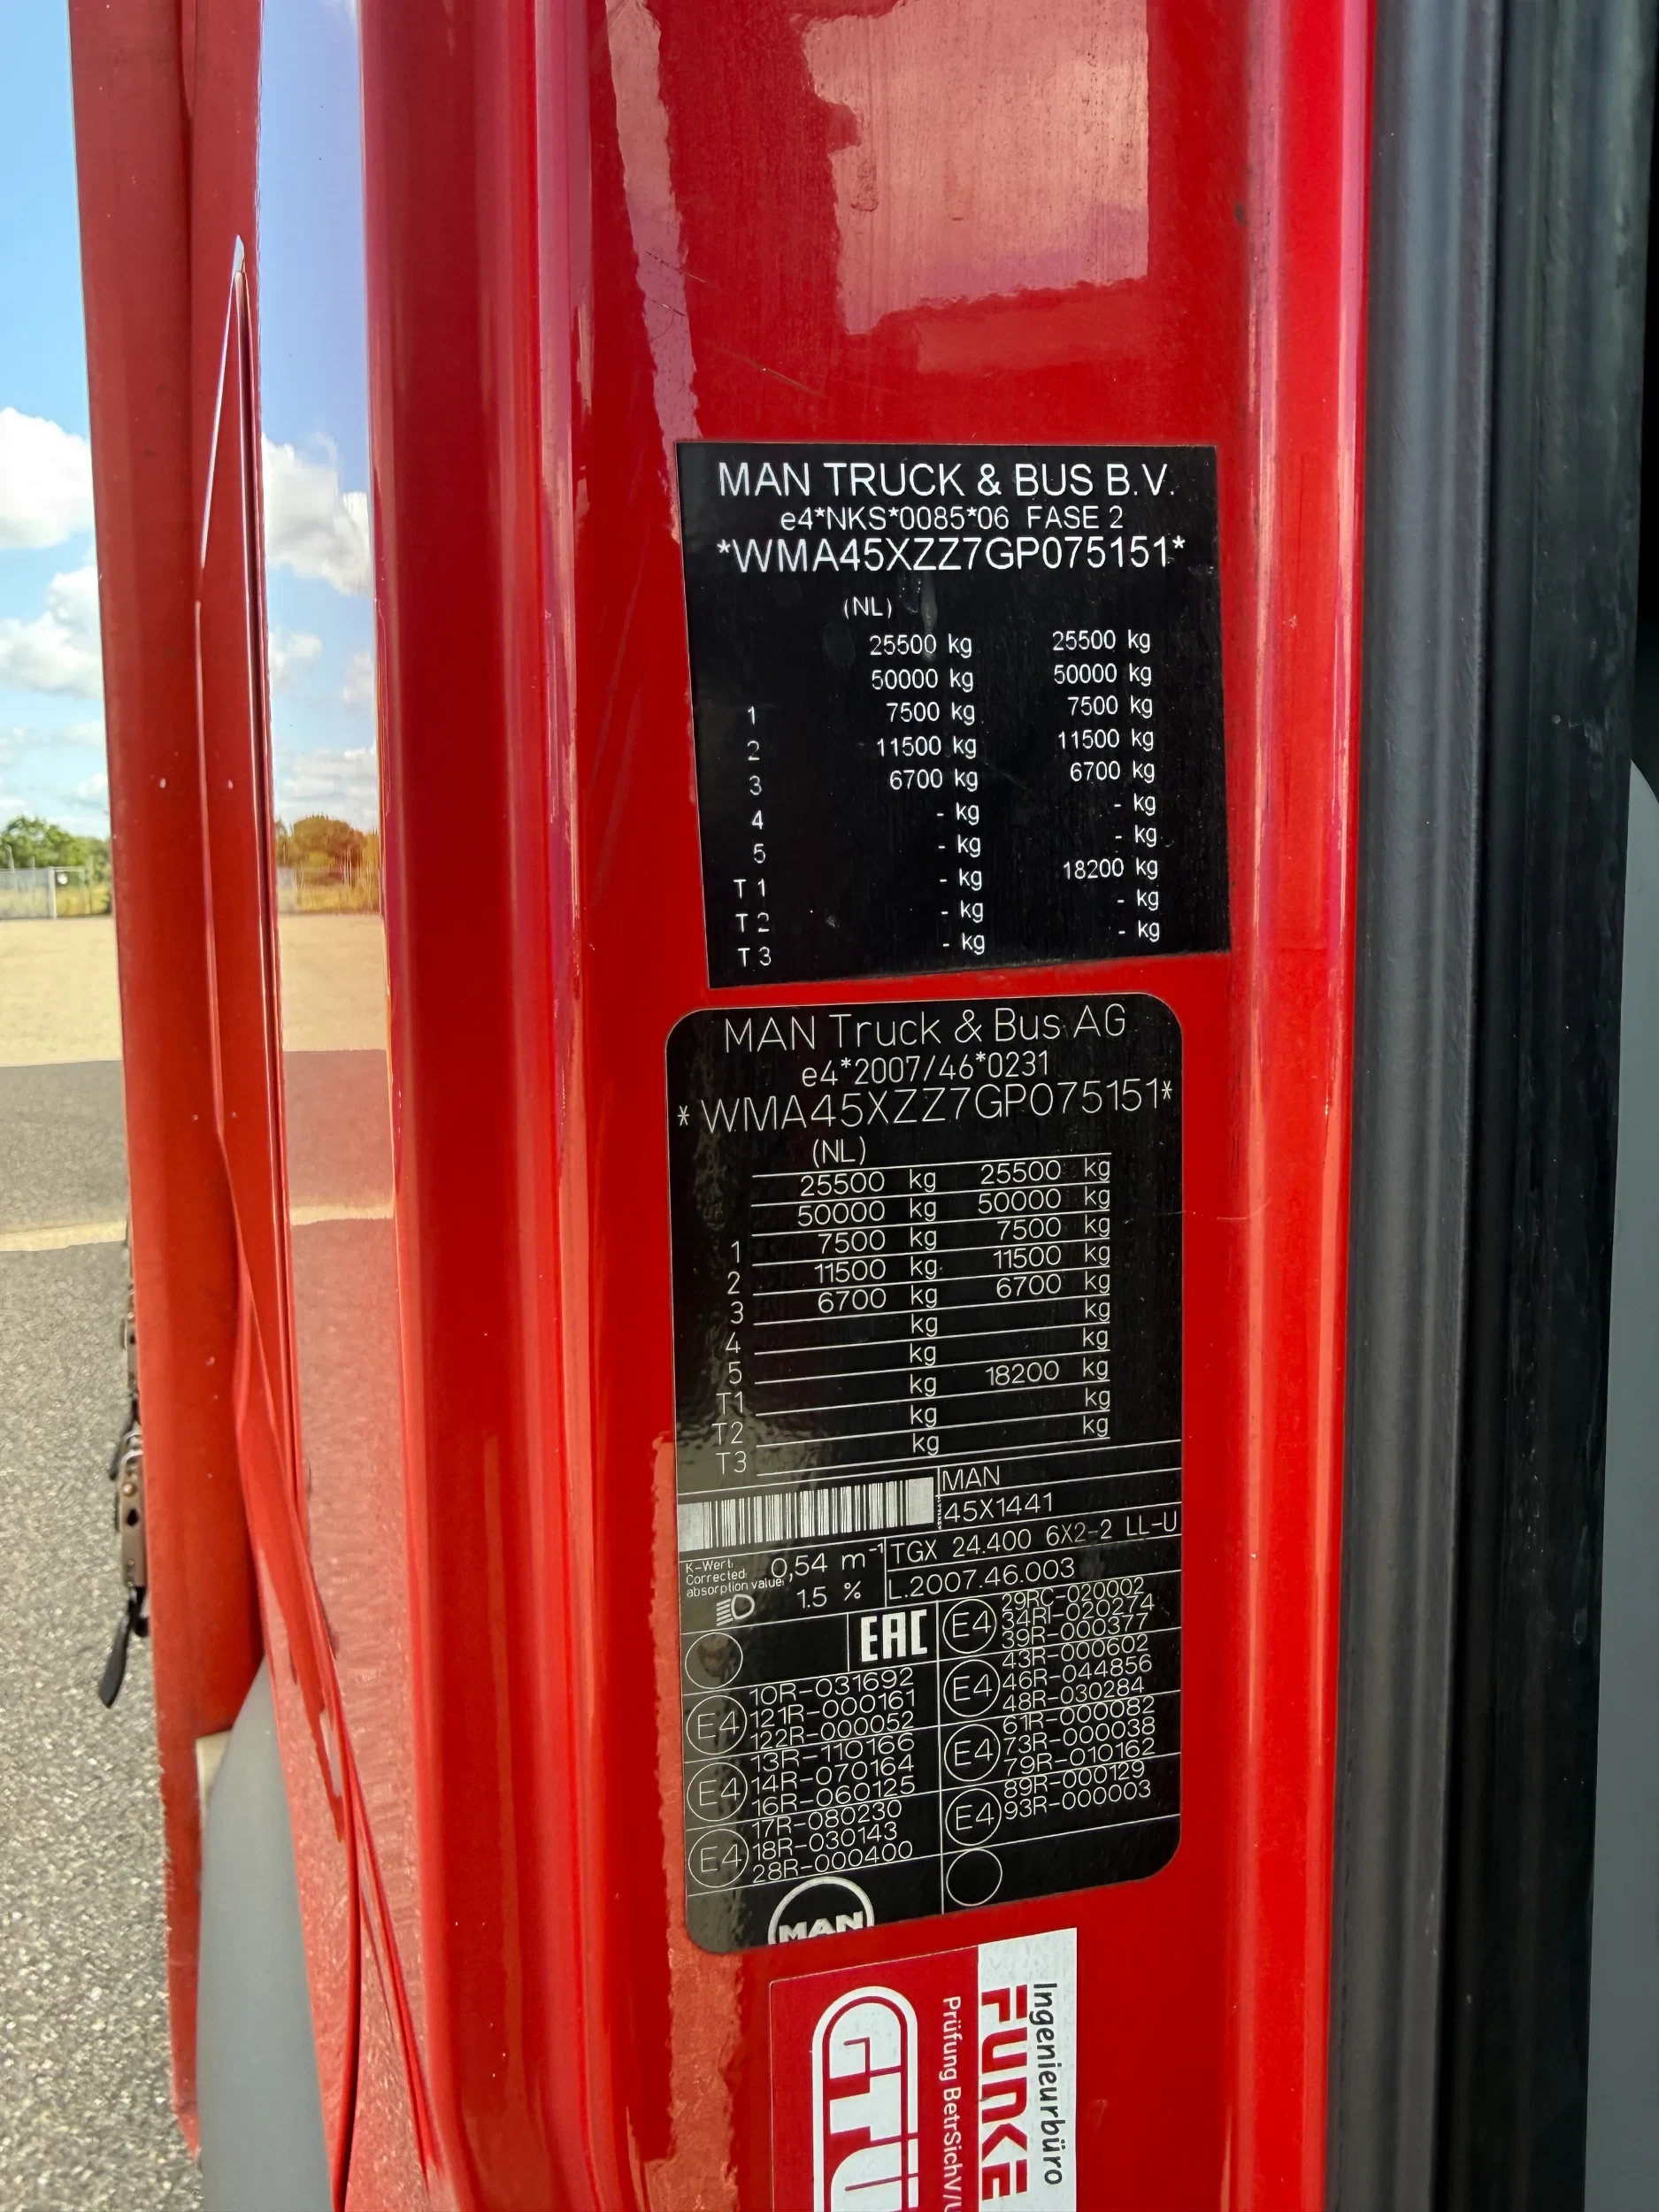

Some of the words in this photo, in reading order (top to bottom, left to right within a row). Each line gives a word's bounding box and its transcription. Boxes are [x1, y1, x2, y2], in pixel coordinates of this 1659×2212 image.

[719, 463, 810, 496] MAN
[823, 463, 965, 496] TRUCK
[978, 464, 1002, 495] &
[1016, 464, 1093, 495] BUS
[1027, 505, 1099, 529] FASE
[1110, 505, 1123, 528] 2
[843, 596, 892, 619] (NL)
[870, 634, 936, 658] 25500
[949, 634, 972, 658] kg
[1053, 630, 1116, 652] 25500
[1128, 629, 1150, 654] kg
[872, 669, 938, 690] 50000
[950, 668, 973, 693] kg
[1055, 663, 1117, 684] 50000
[1129, 663, 1151, 687] kg
[748, 706, 755, 725] 1
[887, 702, 940, 722] 7500
[952, 702, 975, 726] kg
[1068, 695, 1118, 716] 7500
[1131, 695, 1152, 718] kg
[748, 741, 760, 761] 2
[877, 735, 941, 757] 11500
[953, 735, 976, 759] kg
[1058, 728, 1119, 749] 11500
[1132, 728, 1154, 751] kg
[749, 775, 762, 795] 3
[890, 769, 942, 790] 6700
[955, 768, 978, 792] kg
[1071, 761, 1120, 784] 6700
[1133, 760, 1155, 783] kg
[752, 810, 764, 829] 4
[956, 803, 979, 826] kg
[1134, 793, 1156, 816] kg
[754, 843, 765, 864] 5
[957, 834, 980, 857] kg
[1135, 825, 1156, 848] kg
[959, 868, 982, 891] kg
[1064, 858, 1124, 879] 18200
[1136, 857, 1157, 879] kg
[961, 900, 983, 923] kg
[1137, 888, 1158, 911] kg
[962, 933, 985, 955] kg
[1138, 920, 1159, 942] kg
[726, 1016, 815, 1053] MAN
[829, 1011, 941, 1048] Truck
[955, 1010, 982, 1043] &
[995, 1008, 1060, 1041] Bus
[1073, 1003, 1125, 1038] AG
[813, 1136, 865, 1168] (NL)
[801, 1171, 885, 1196] 25500
[910, 1169, 936, 1192] kg
[981, 1160, 1061, 1184] 25500
[1085, 1157, 1110, 1179] kg
[798, 1201, 885, 1226] 50000
[910, 1199, 937, 1222] kg
[979, 1188, 1061, 1214] 50000
[1085, 1187, 1110, 1209] kg
[731, 1240, 740, 1263] 1
[818, 1230, 885, 1254] 7500
[910, 1228, 937, 1251] kg
[997, 1217, 1061, 1240] 7500
[1085, 1215, 1110, 1238] kg
[727, 1271, 740, 1294] 2
[814, 1259, 886, 1283] 11500
[910, 1256, 937, 1279] kg
[994, 1246, 1061, 1269] 11500
[1085, 1242, 1110, 1265] kg
[731, 1302, 743, 1324] 3
[818, 1288, 886, 1313] 6700
[911, 1285, 938, 1308] kg
[997, 1274, 1061, 1298] 6700
[1085, 1271, 1110, 1294] kg
[726, 1332, 741, 1353] 4
[911, 1315, 938, 1337] kg
[1085, 1299, 1110, 1322] kg
[729, 1361, 741, 1385] 5
[910, 1344, 936, 1366] kg
[1083, 1327, 1108, 1349] kg
[716, 1391, 742, 1415] T1
[910, 1374, 936, 1397] kg
[986, 1361, 1059, 1386] 18200
[1083, 1357, 1108, 1379] kg
[711, 1421, 743, 1445] T2
[910, 1405, 937, 1428] kg
[1085, 1387, 1110, 1409] kg
[716, 1451, 746, 1475] T3
[912, 1433, 939, 1456] kg
[1083, 1415, 1108, 1437] kg
[943, 1465, 999, 1491] MAN
[944, 1492, 1051, 1523] 45X1441
[890, 1540, 937, 1563] TGX
[953, 1529, 1031, 1557] 24.400
[1047, 1519, 1111, 1546] 6X2-2
[687, 1576, 748, 1597] absorption
[772, 1553, 827, 1582] 0,54
[889, 1557, 1074, 1600] L.2007.46.003
[796, 1586, 827, 1609] 1.5
[844, 1580, 861, 1601] %
[1002, 1577, 1144, 1611] 29RC-020002
[1002, 1594, 1155, 1632] 34RI-020274
[861, 1609, 927, 1663] EAC
[953, 1610, 991, 1638] E4
[1002, 1609, 1148, 1648] 39R-000377
[1002, 1634, 1148, 1669] 43R-000602
[749, 1667, 914, 1709] 10R-031692
[954, 1674, 992, 1701] E4
[1002, 1654, 1152, 1693] 46R-044856
[1002, 1675, 1144, 1711] 48R-030284
[698, 1710, 740, 1740] E4
[749, 1688, 914, 1731] 121R-000161
[1003, 1699, 1155, 1734] 61R-000082
[750, 1709, 914, 1751] 122R-000052
[1003, 1715, 1155, 1758] 73R-000038
[750, 1731, 914, 1772] 13R-110166
[955, 1739, 995, 1766] E4
[1003, 1735, 1155, 1776] 79R-010162
[699, 1778, 741, 1806] E4
[750, 1752, 915, 1797] 14R-070164
[1004, 1760, 1144, 1799] 89R-000129
[751, 1774, 915, 1817] 16R-060125
[1004, 1779, 1150, 1820] 93R-000003
[752, 1797, 902, 1841] 17R-080230
[956, 1802, 995, 1831] E4
[701, 1844, 741, 1873] E4
[752, 1821, 897, 1863] 18R-030143
[753, 1841, 912, 1884] 28R-000400
[780, 1911, 863, 1943] MAN
[939, 1996, 962, 2081] Prüfung
[1029, 1983, 1065, 2185] Ingenieurbüro
